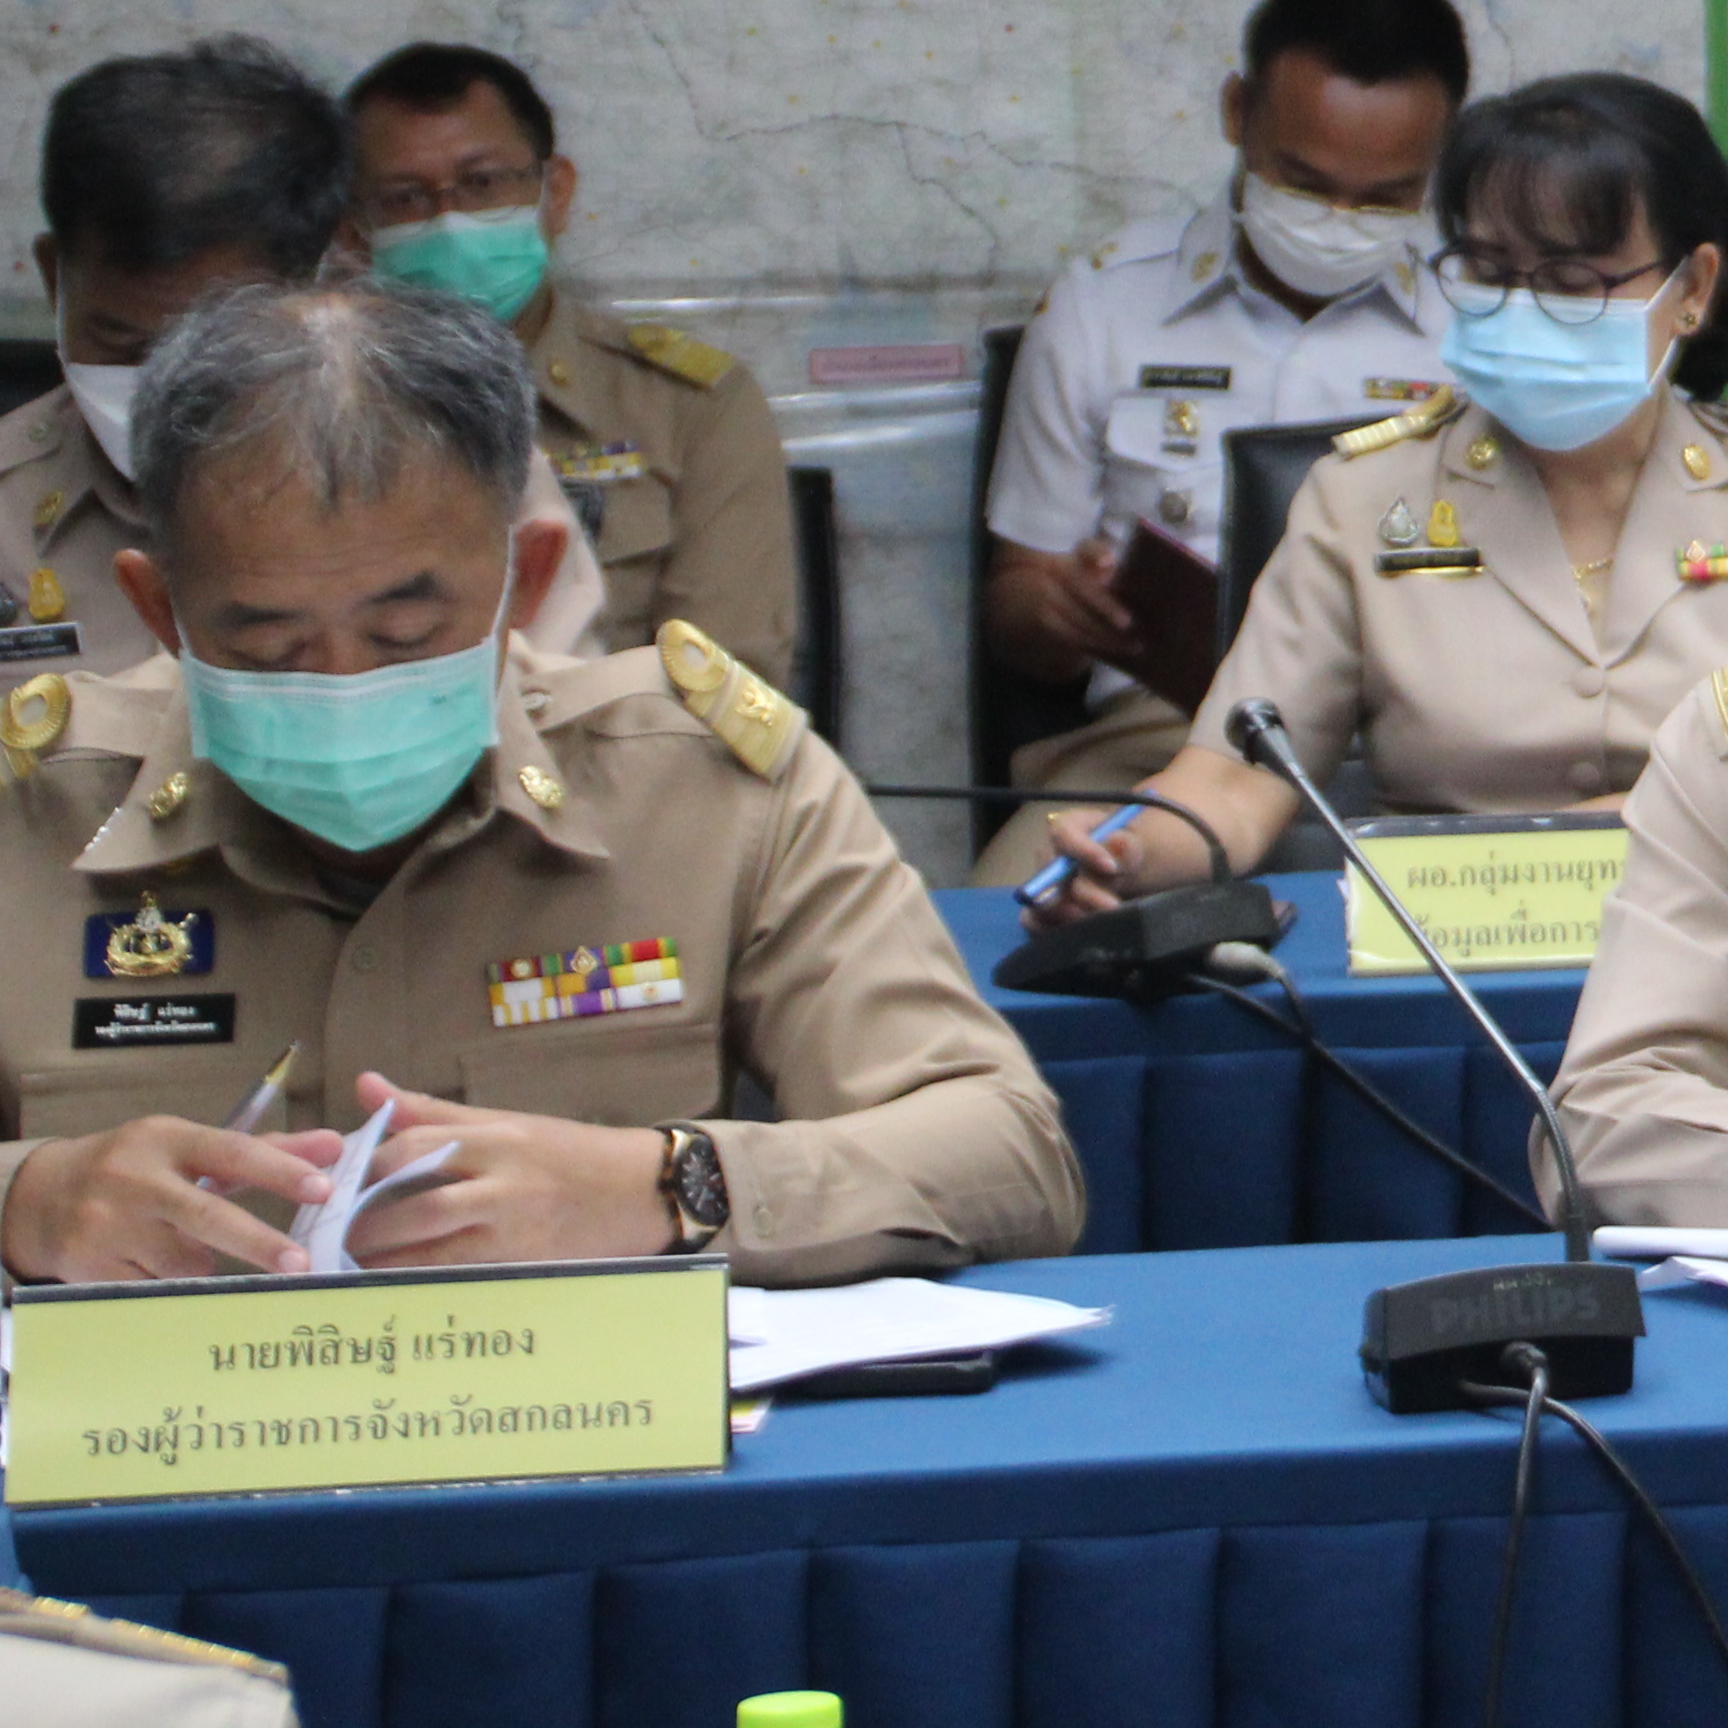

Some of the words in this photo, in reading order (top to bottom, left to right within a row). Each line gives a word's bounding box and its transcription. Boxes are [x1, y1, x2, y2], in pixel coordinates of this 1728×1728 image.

[1407, 850, 1625, 895] ผอ.กลุ่มงานยุท
[1431, 1285, 1600, 1334] PHILIPS
[208, 1314, 398, 1375] นายพิสิษฐ์
[412, 1316, 537, 1361] แร่ทอง
[80, 1393, 655, 1468] รองผู้ว่าราชการจังหวัดสกลนคร
